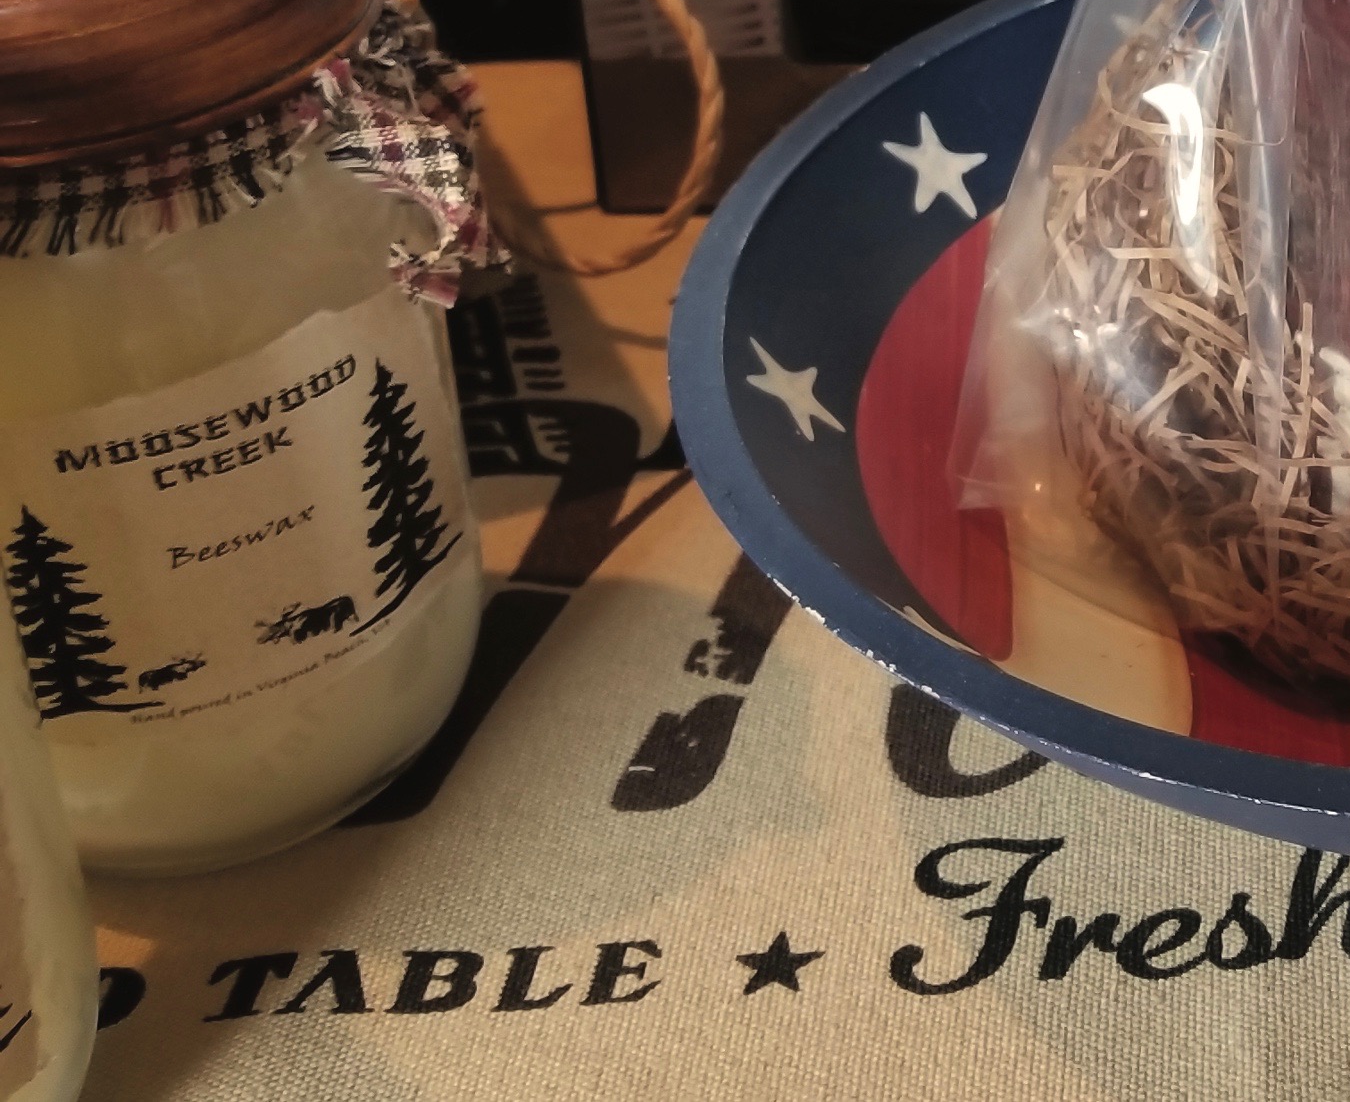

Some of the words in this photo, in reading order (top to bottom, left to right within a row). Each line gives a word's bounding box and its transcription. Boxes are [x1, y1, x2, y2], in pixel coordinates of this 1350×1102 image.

[53, 353, 357, 474] MOOSEWOOD
[152, 426, 293, 491] CREEK
[166, 504, 316, 570] Beeswax
[202, 938, 663, 1024] TABLE
